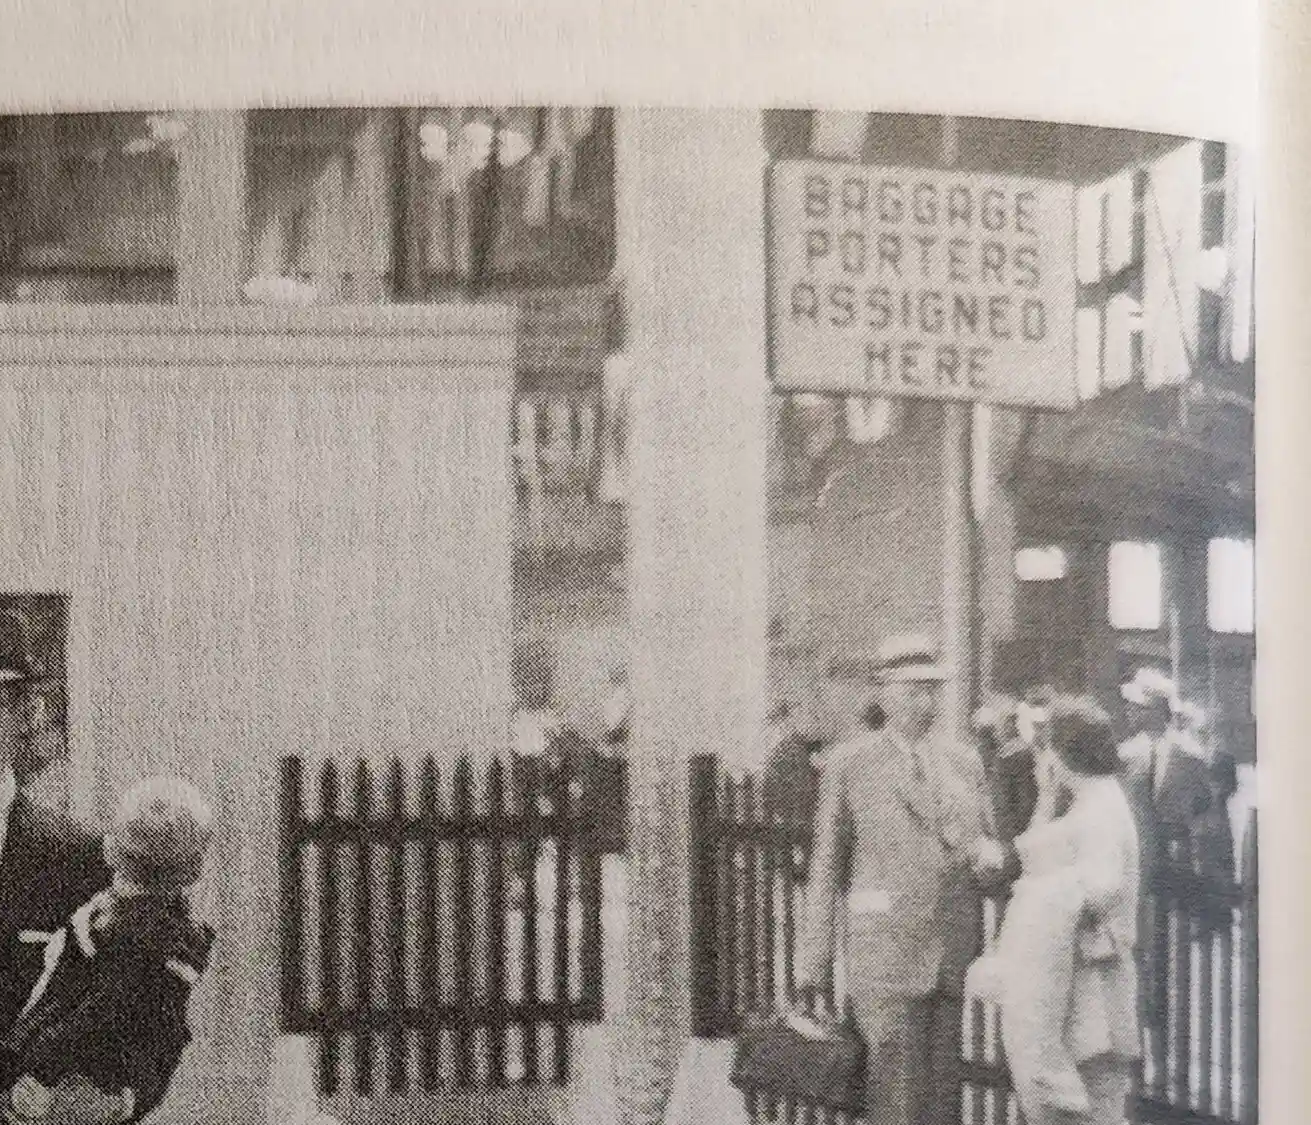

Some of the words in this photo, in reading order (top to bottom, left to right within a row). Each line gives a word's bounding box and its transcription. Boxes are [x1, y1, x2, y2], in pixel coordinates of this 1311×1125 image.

[803, 174, 1042, 236] BAGGAGE
[804, 227, 1043, 290] PORTERS
[790, 281, 1048, 343] ASSIGNED
[864, 340, 991, 390] HERE
